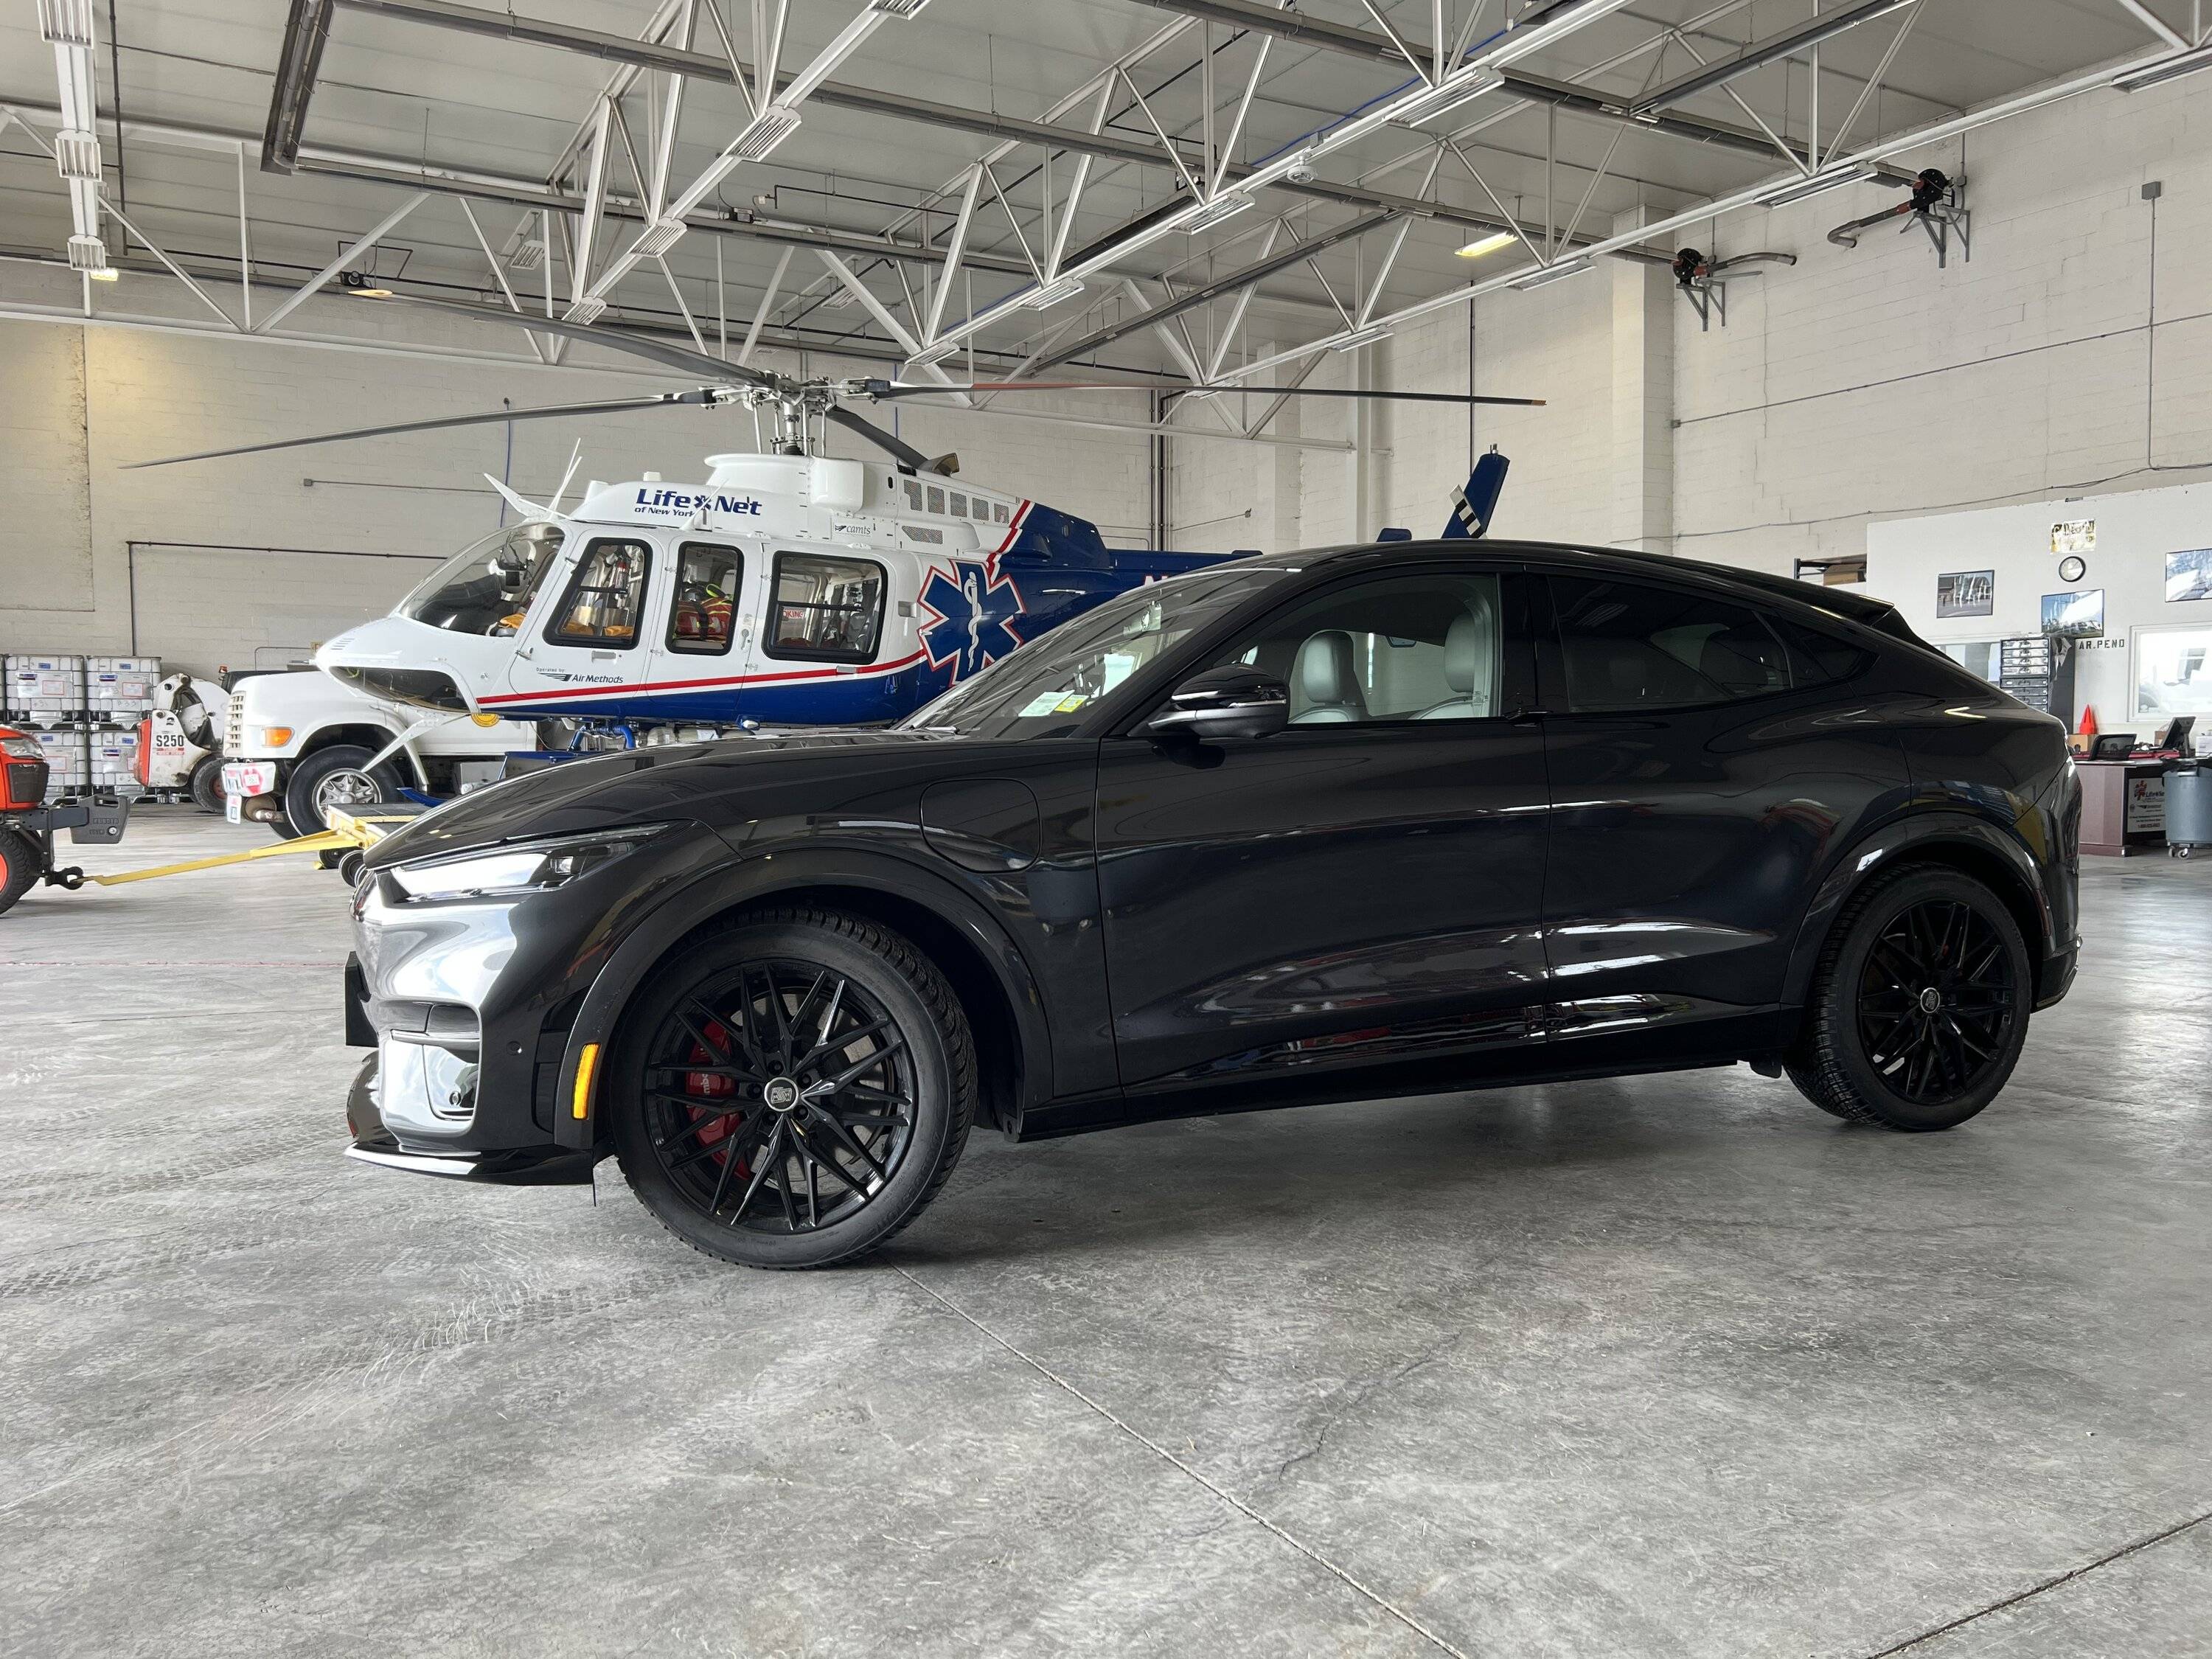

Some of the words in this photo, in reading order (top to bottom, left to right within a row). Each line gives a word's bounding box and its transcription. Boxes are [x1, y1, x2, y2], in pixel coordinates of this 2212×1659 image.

[636, 488, 692, 509] Life
[714, 495, 763, 516] Net
[634, 506, 647, 514] of
[648, 507, 670, 515] New
[846, 525, 871, 535] camts
[571, 674, 585, 682] Air
[585, 675, 624, 684] Methods
[156, 734, 184, 747] S250
